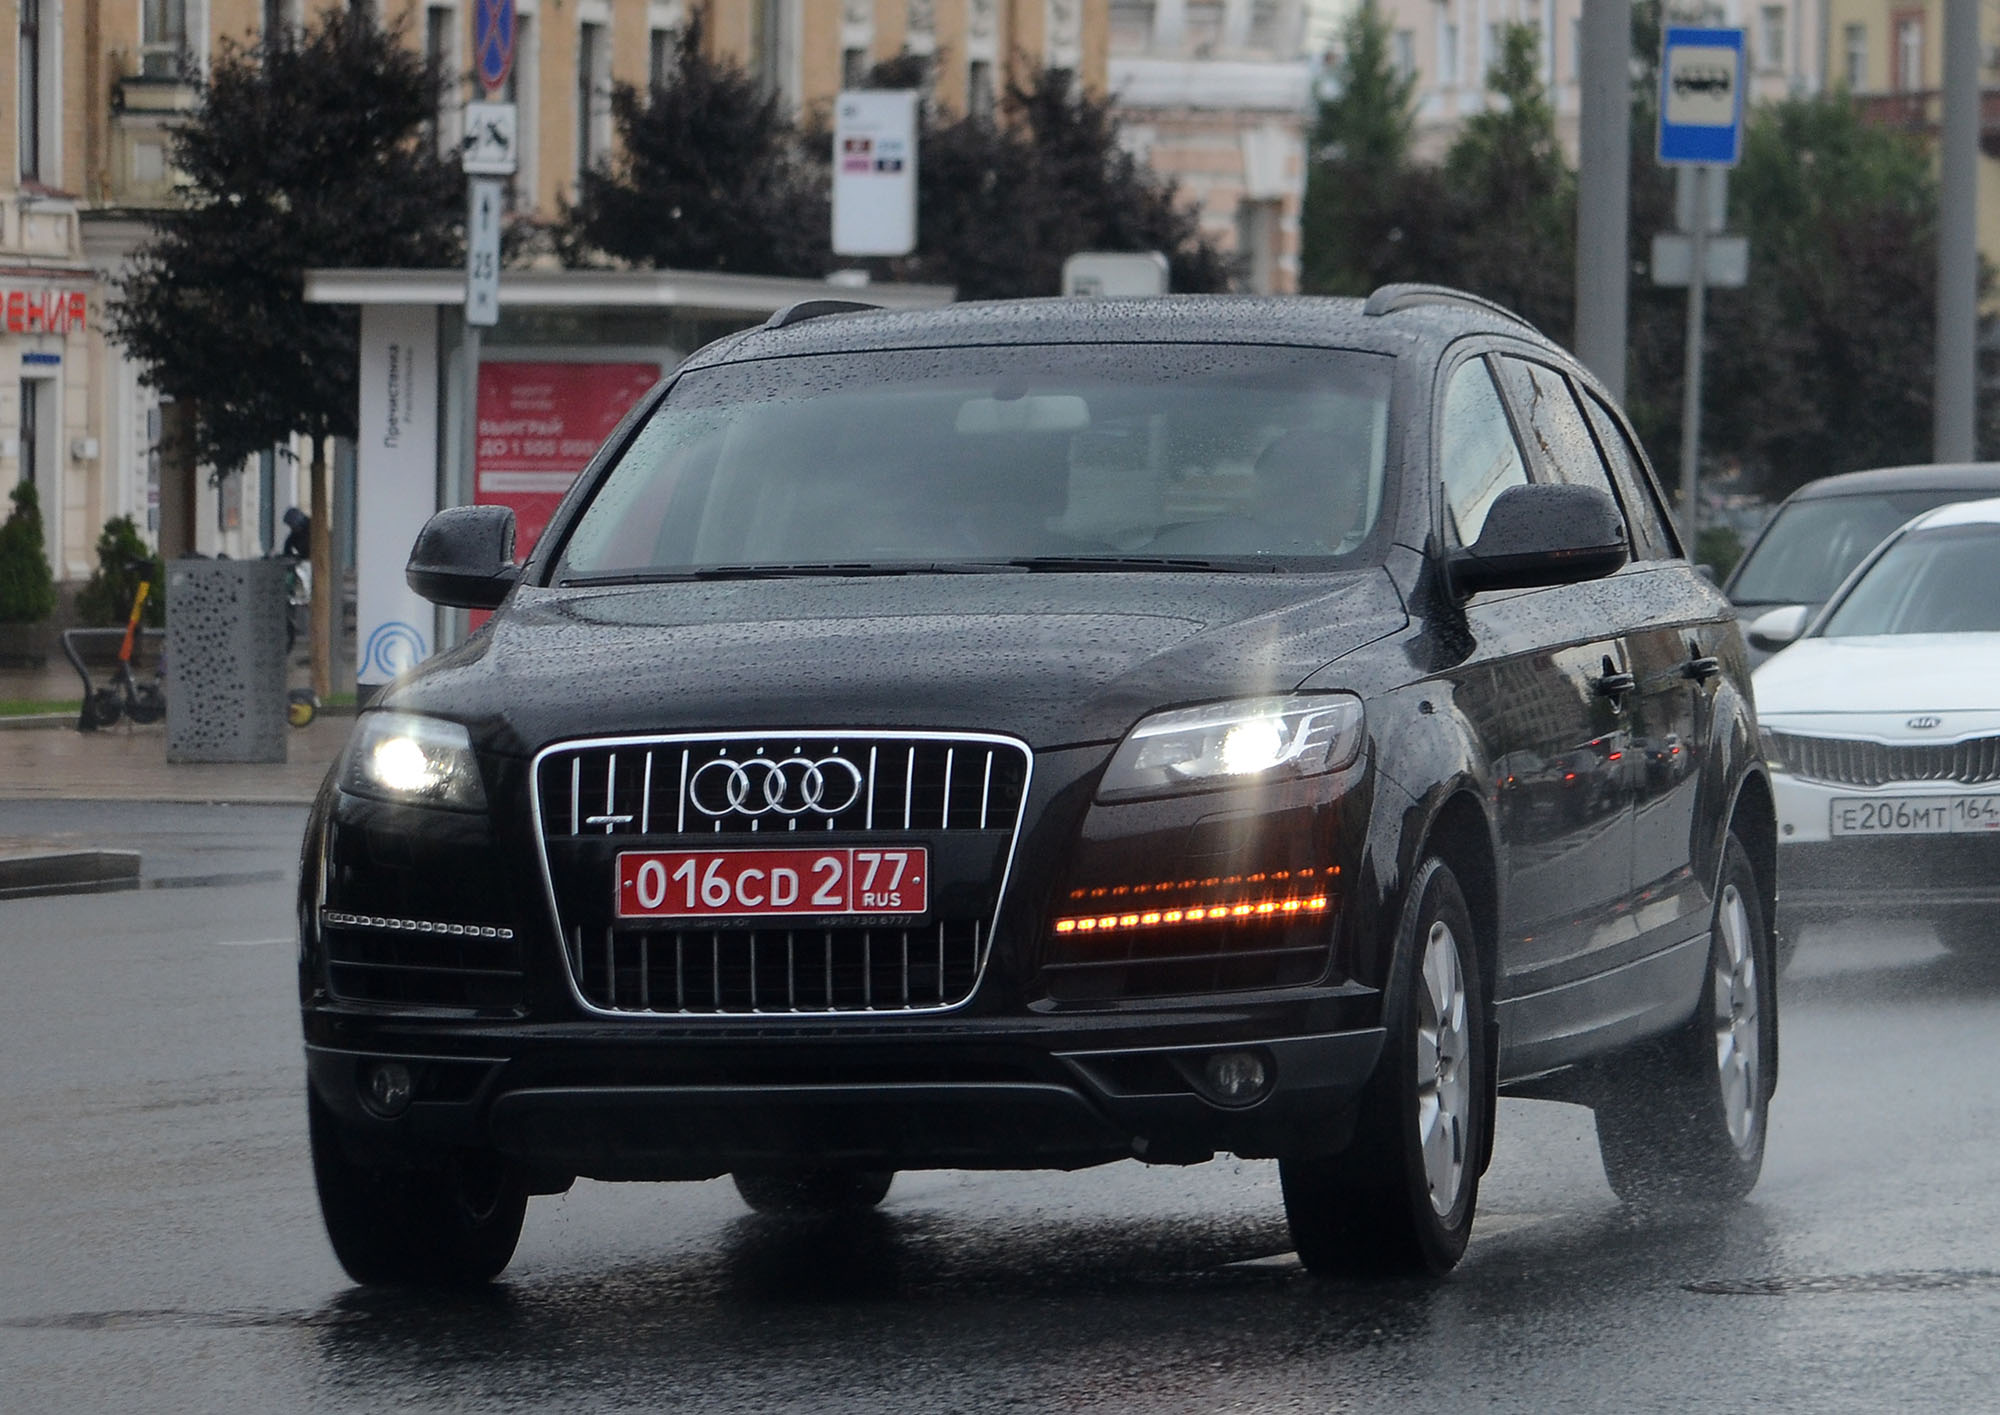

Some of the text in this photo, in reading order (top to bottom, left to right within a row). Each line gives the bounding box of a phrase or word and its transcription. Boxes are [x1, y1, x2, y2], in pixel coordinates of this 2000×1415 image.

[0, 291, 86, 334] ЕНИЯ
[384, 344, 399, 448] Пречистенка
[1955, 799, 1993, 819] 164
[811, 856, 843, 905] 2
[857, 852, 908, 891] 77
[863, 892, 902, 907] RUS
